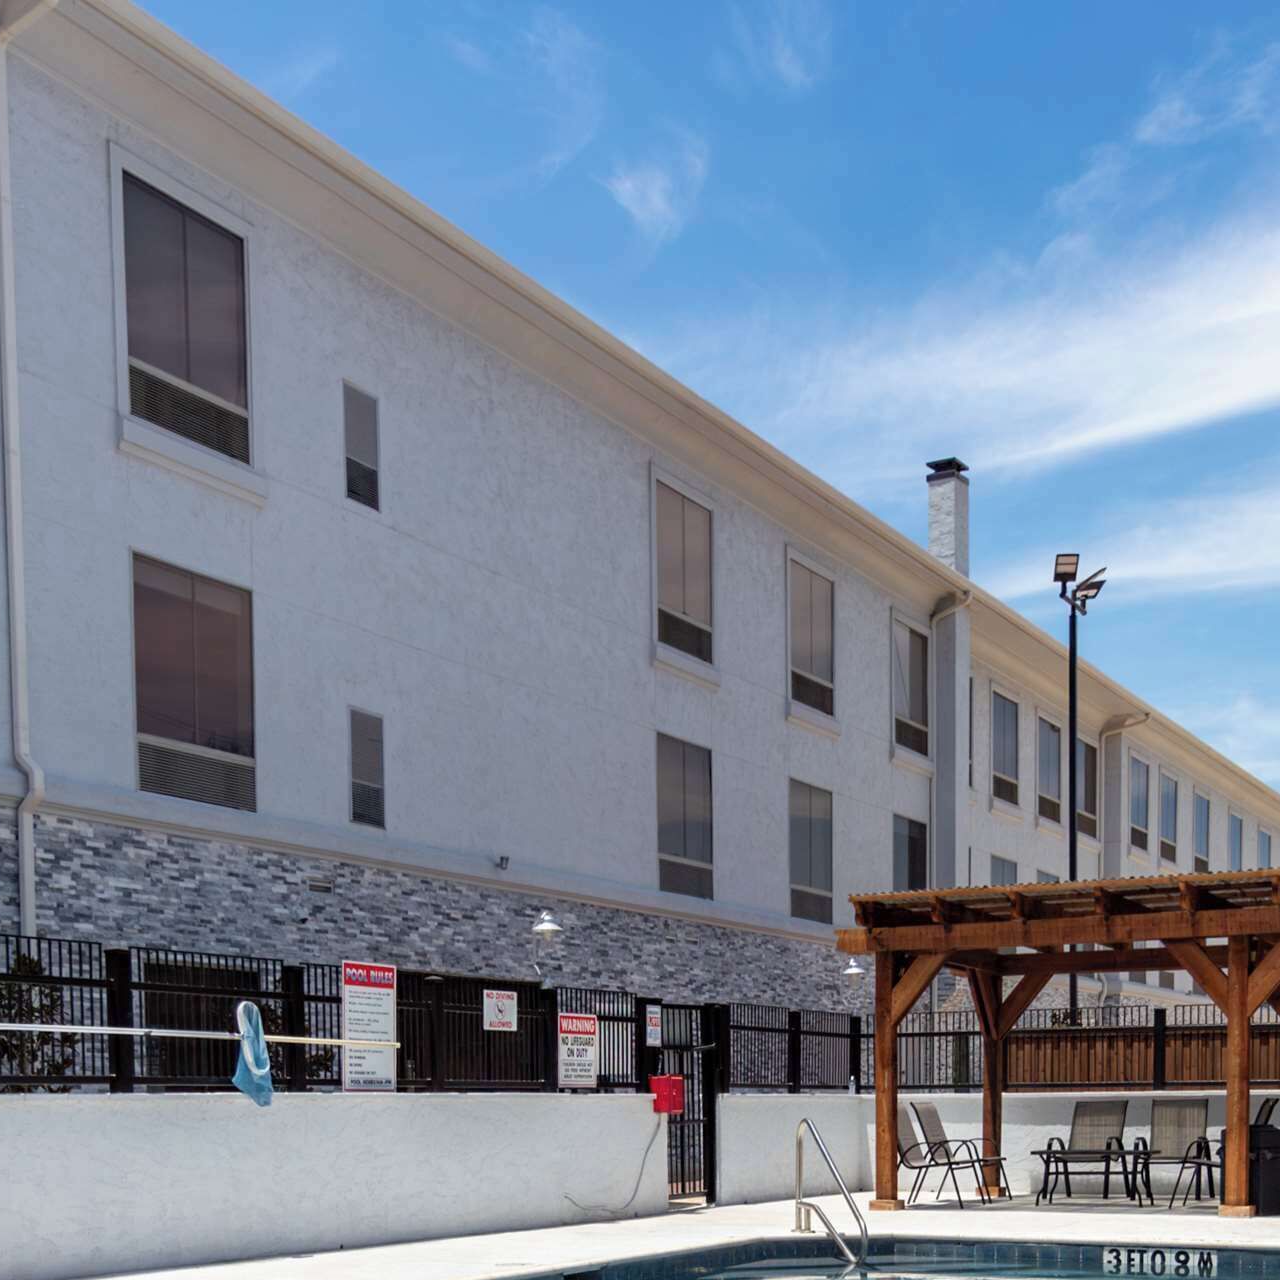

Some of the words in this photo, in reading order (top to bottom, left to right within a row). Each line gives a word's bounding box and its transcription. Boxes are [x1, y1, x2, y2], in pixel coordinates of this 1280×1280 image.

[346, 967, 367, 982] POOL
[370, 970, 393, 985] RULES
[560, 1017, 595, 1034] WARNING
[571, 1036, 594, 1048] LIFEGUARD
[567, 1047, 575, 1058] ON
[576, 1048, 588, 1058] DUTY
